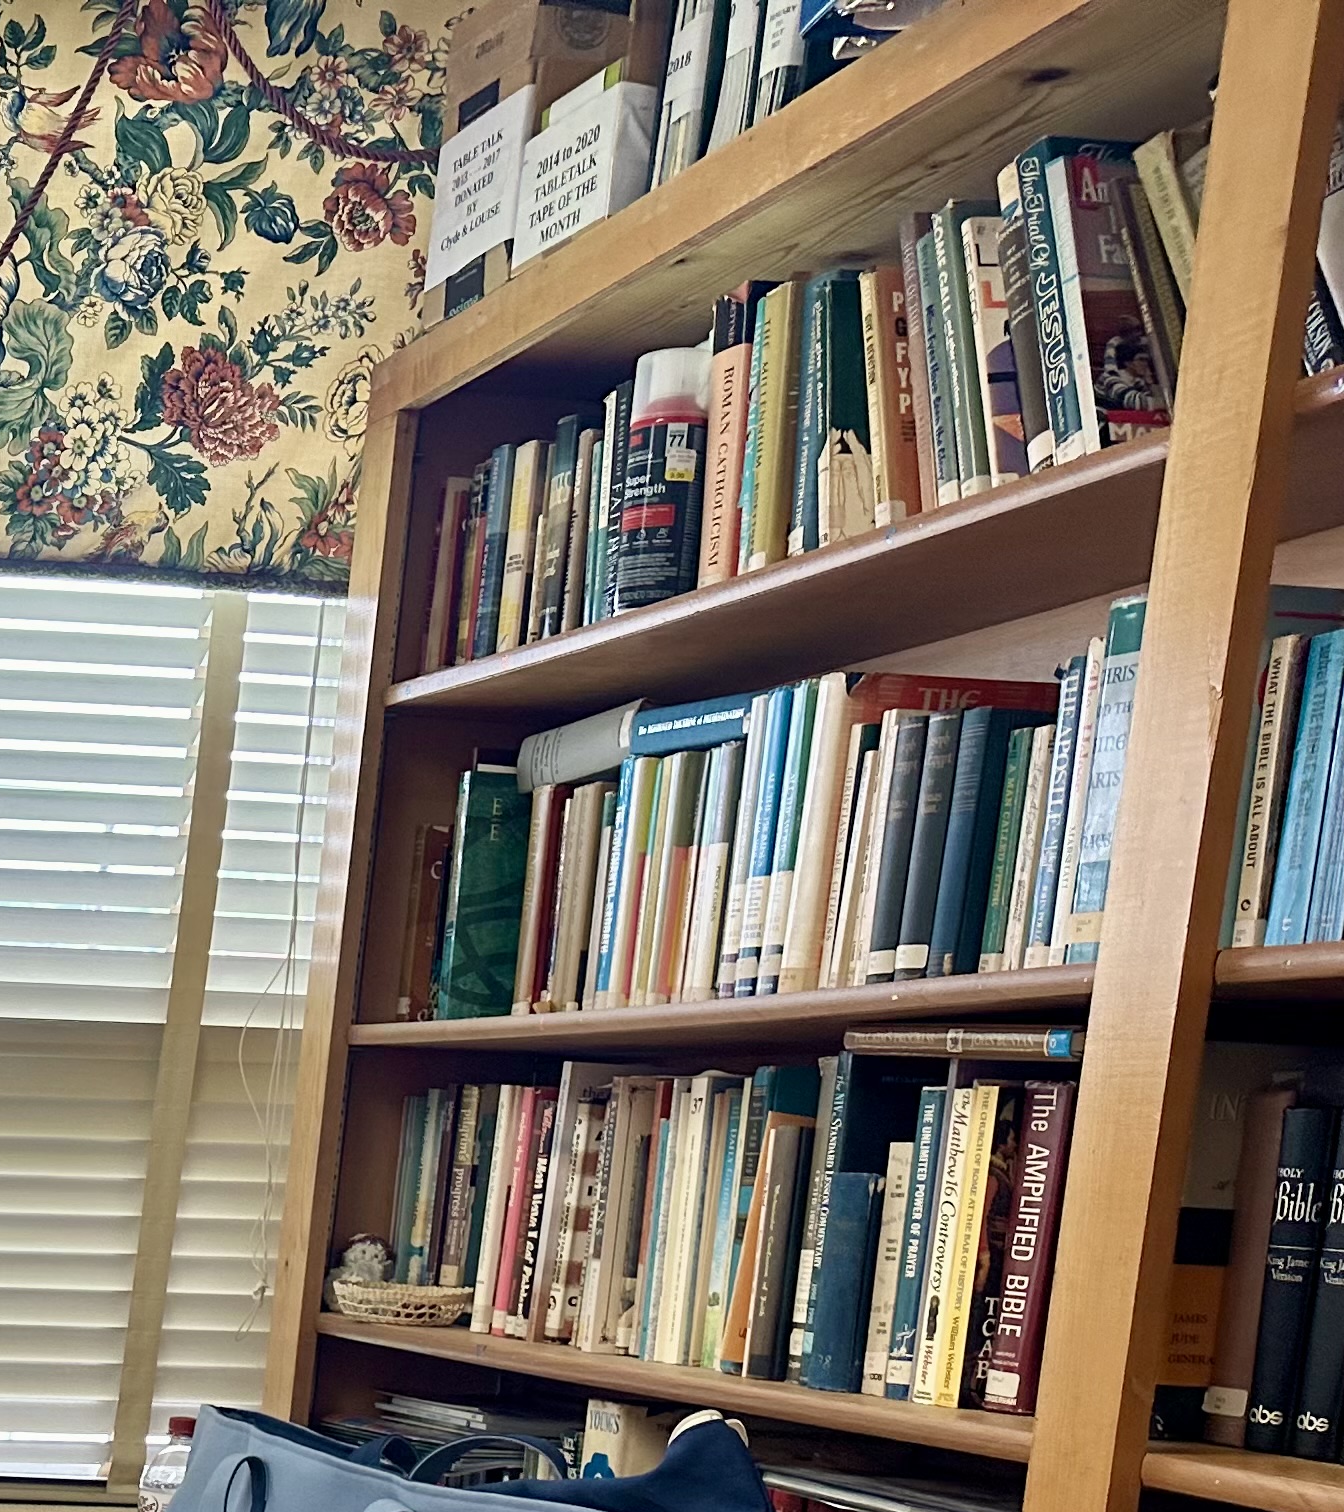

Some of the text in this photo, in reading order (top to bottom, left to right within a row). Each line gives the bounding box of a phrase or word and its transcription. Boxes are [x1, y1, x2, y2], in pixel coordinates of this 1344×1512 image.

[452, 128, 504, 173] TABLE TALK
[536, 124, 601, 179] 2014 to 2020
[454, 171, 494, 208] DONATED
[1020, 156, 1040, 196] The
[466, 199, 479, 217] BY
[469, 201, 501, 232] LOUISE
[529, 174, 598, 229] TAPE OF THE
[1024, 194, 1048, 244] Trial
[538, 208, 581, 246] MONTH
[931, 213, 952, 318] SOME GALL
[1036, 272, 1069, 394] JESUS
[669, 434, 684, 447] 77
[708, 366, 735, 568] ROMAN CATHOLICISM
[1062, 667, 1081, 723] THE
[1245, 656, 1282, 869] WHAT THE BIBLE IS ALL ABOUT
[825, 767, 855, 942] CHRISTIANS ARE CITIZENS
[691, 1097, 703, 1115] 37
[832, 1091, 846, 1114] NIV
[1030, 1090, 1057, 1132] The
[458, 1109, 471, 1163] pilgrim's
[826, 1116, 842, 1169] STANDARD
[450, 1168, 465, 1218] progress
[904, 1103, 935, 1279] THE UNLIMITED POWER OF PRAYER
[930, 1090, 971, 1292] The Matthew 16 Controversy
[1278, 1167, 1305, 1179] HOLY
[595, 1186, 607, 1236] SINS
[1011, 1143, 1051, 1262] AMPLIFIED
[1274, 1181, 1322, 1225] Bible
[813, 1206, 831, 1268] COMMENTARY
[943, 1091, 990, 1390] THE CHURCH OF ROME AT THE BAR OF HISTORY William Webster
[1286, 1255, 1309, 1268] Jame
[997, 1274, 1030, 1338] BIBLE
[1173, 1314, 1208, 1325] JAMES
[1167, 1354, 1217, 1366] GENERA
[1170, 1333, 1200, 1345] JUDE
[919, 1345, 934, 1386] Webster
[1249, 1404, 1284, 1426] abs
[1297, 1411, 1329, 1432] abs
